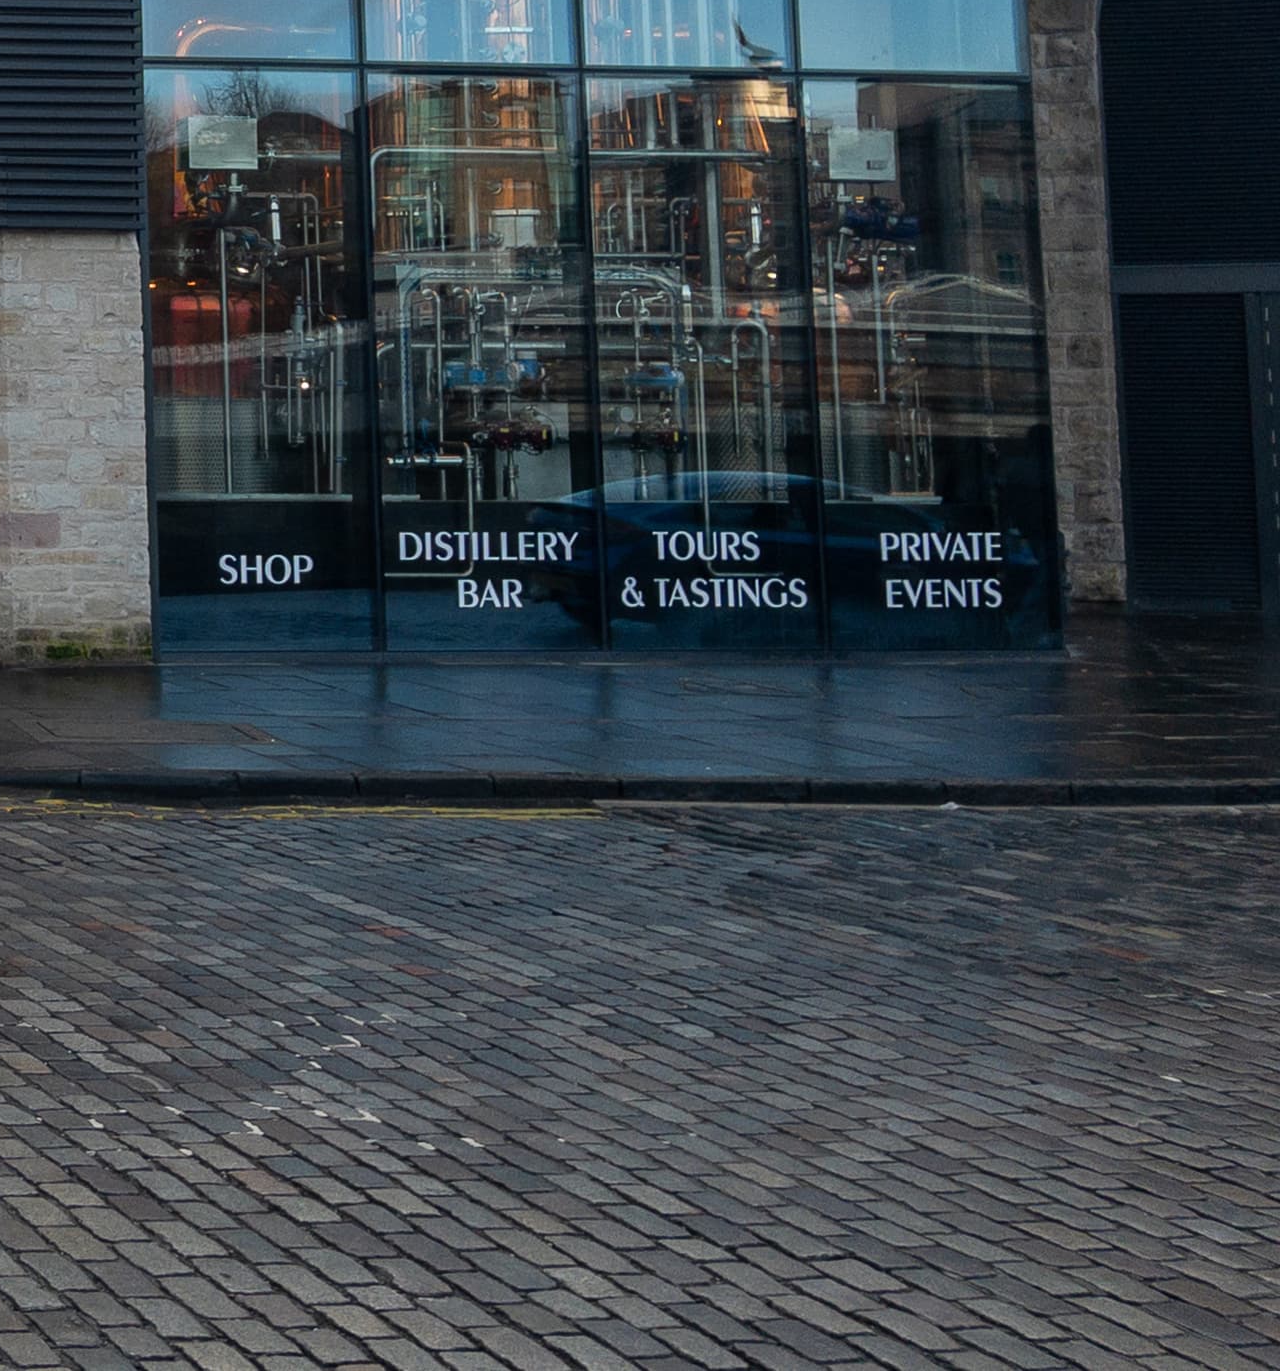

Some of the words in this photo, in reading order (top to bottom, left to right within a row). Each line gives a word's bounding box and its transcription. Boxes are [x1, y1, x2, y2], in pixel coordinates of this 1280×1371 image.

[398, 530, 579, 562] DISTILLERY
[651, 530, 761, 562] TOURS
[879, 531, 1003, 562] PRIVATE
[218, 554, 314, 586] SHOP
[458, 578, 524, 609] BAR
[620, 577, 645, 608] &
[654, 577, 808, 609] TASTINGS
[885, 578, 1003, 609] EVENTS
